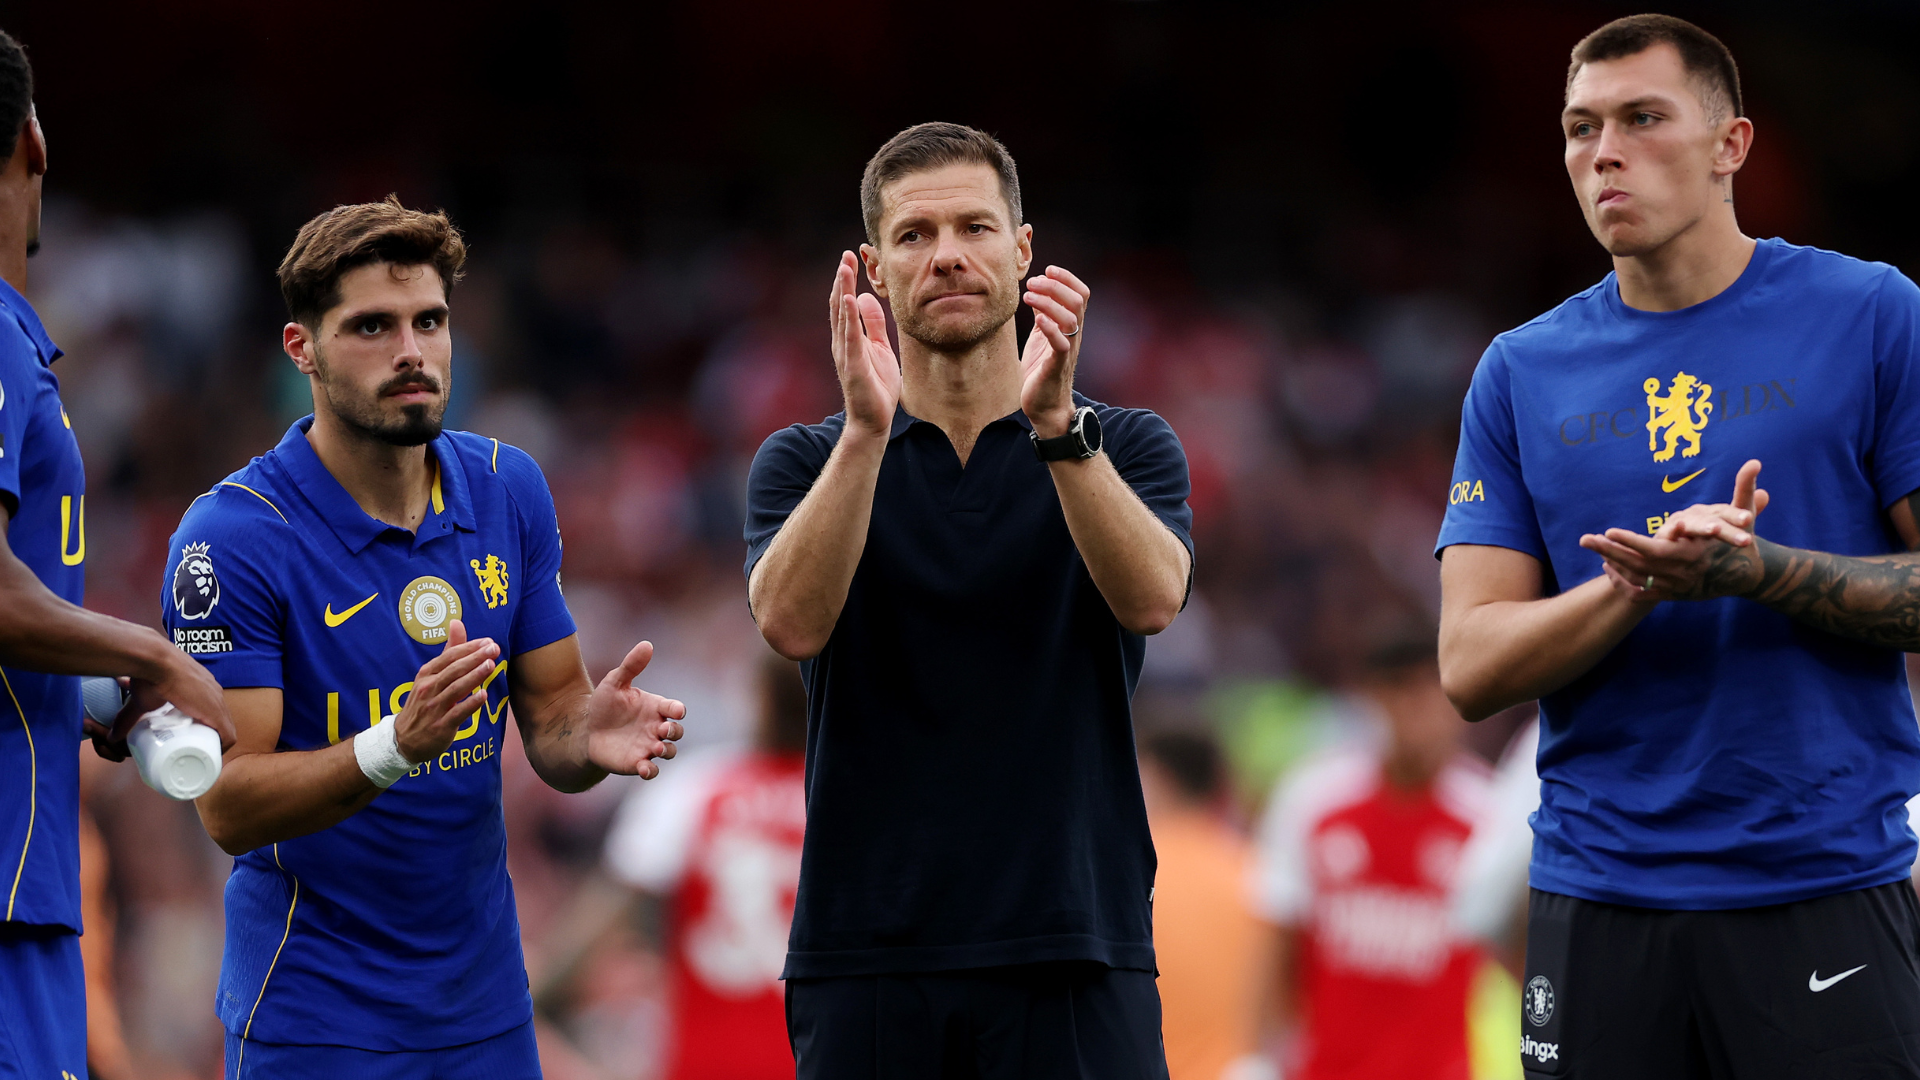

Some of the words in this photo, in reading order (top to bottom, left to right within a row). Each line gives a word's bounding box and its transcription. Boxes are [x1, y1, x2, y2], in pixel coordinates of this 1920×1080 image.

[1559, 408, 1639, 446] CFC
[1718, 378, 1797, 423] LDN
[1450, 479, 1485, 505] ORA
[404, 589, 418, 622] WORLD
[417, 582, 457, 615] CHAMPIONS
[174, 628, 186, 642] No
[187, 629, 225, 642] room
[422, 627, 447, 640] FIFA
[187, 640, 233, 654] racism
[438, 737, 494, 771] CIRCLE
